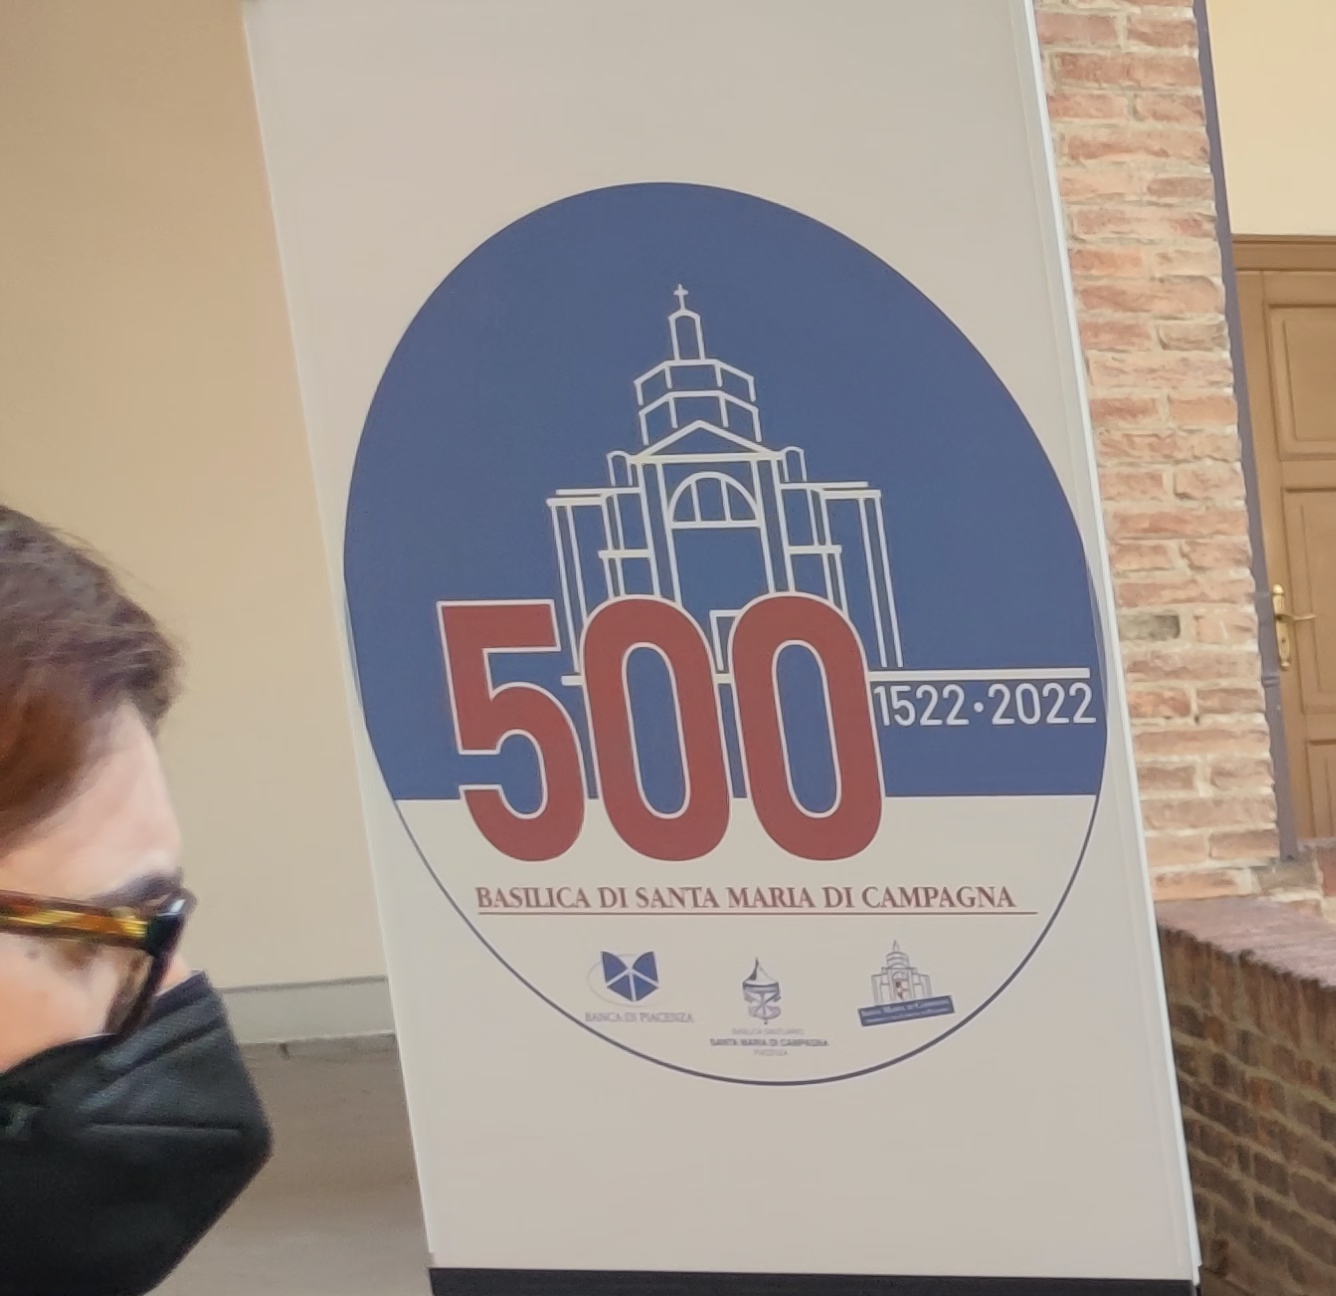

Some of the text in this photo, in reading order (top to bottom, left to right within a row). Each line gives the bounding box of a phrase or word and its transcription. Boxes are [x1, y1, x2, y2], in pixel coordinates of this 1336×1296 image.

[437, 591, 885, 861] 500
[475, 886, 1017, 909] BASILICA DI SANTA MARIA DI CAMPAGNA
